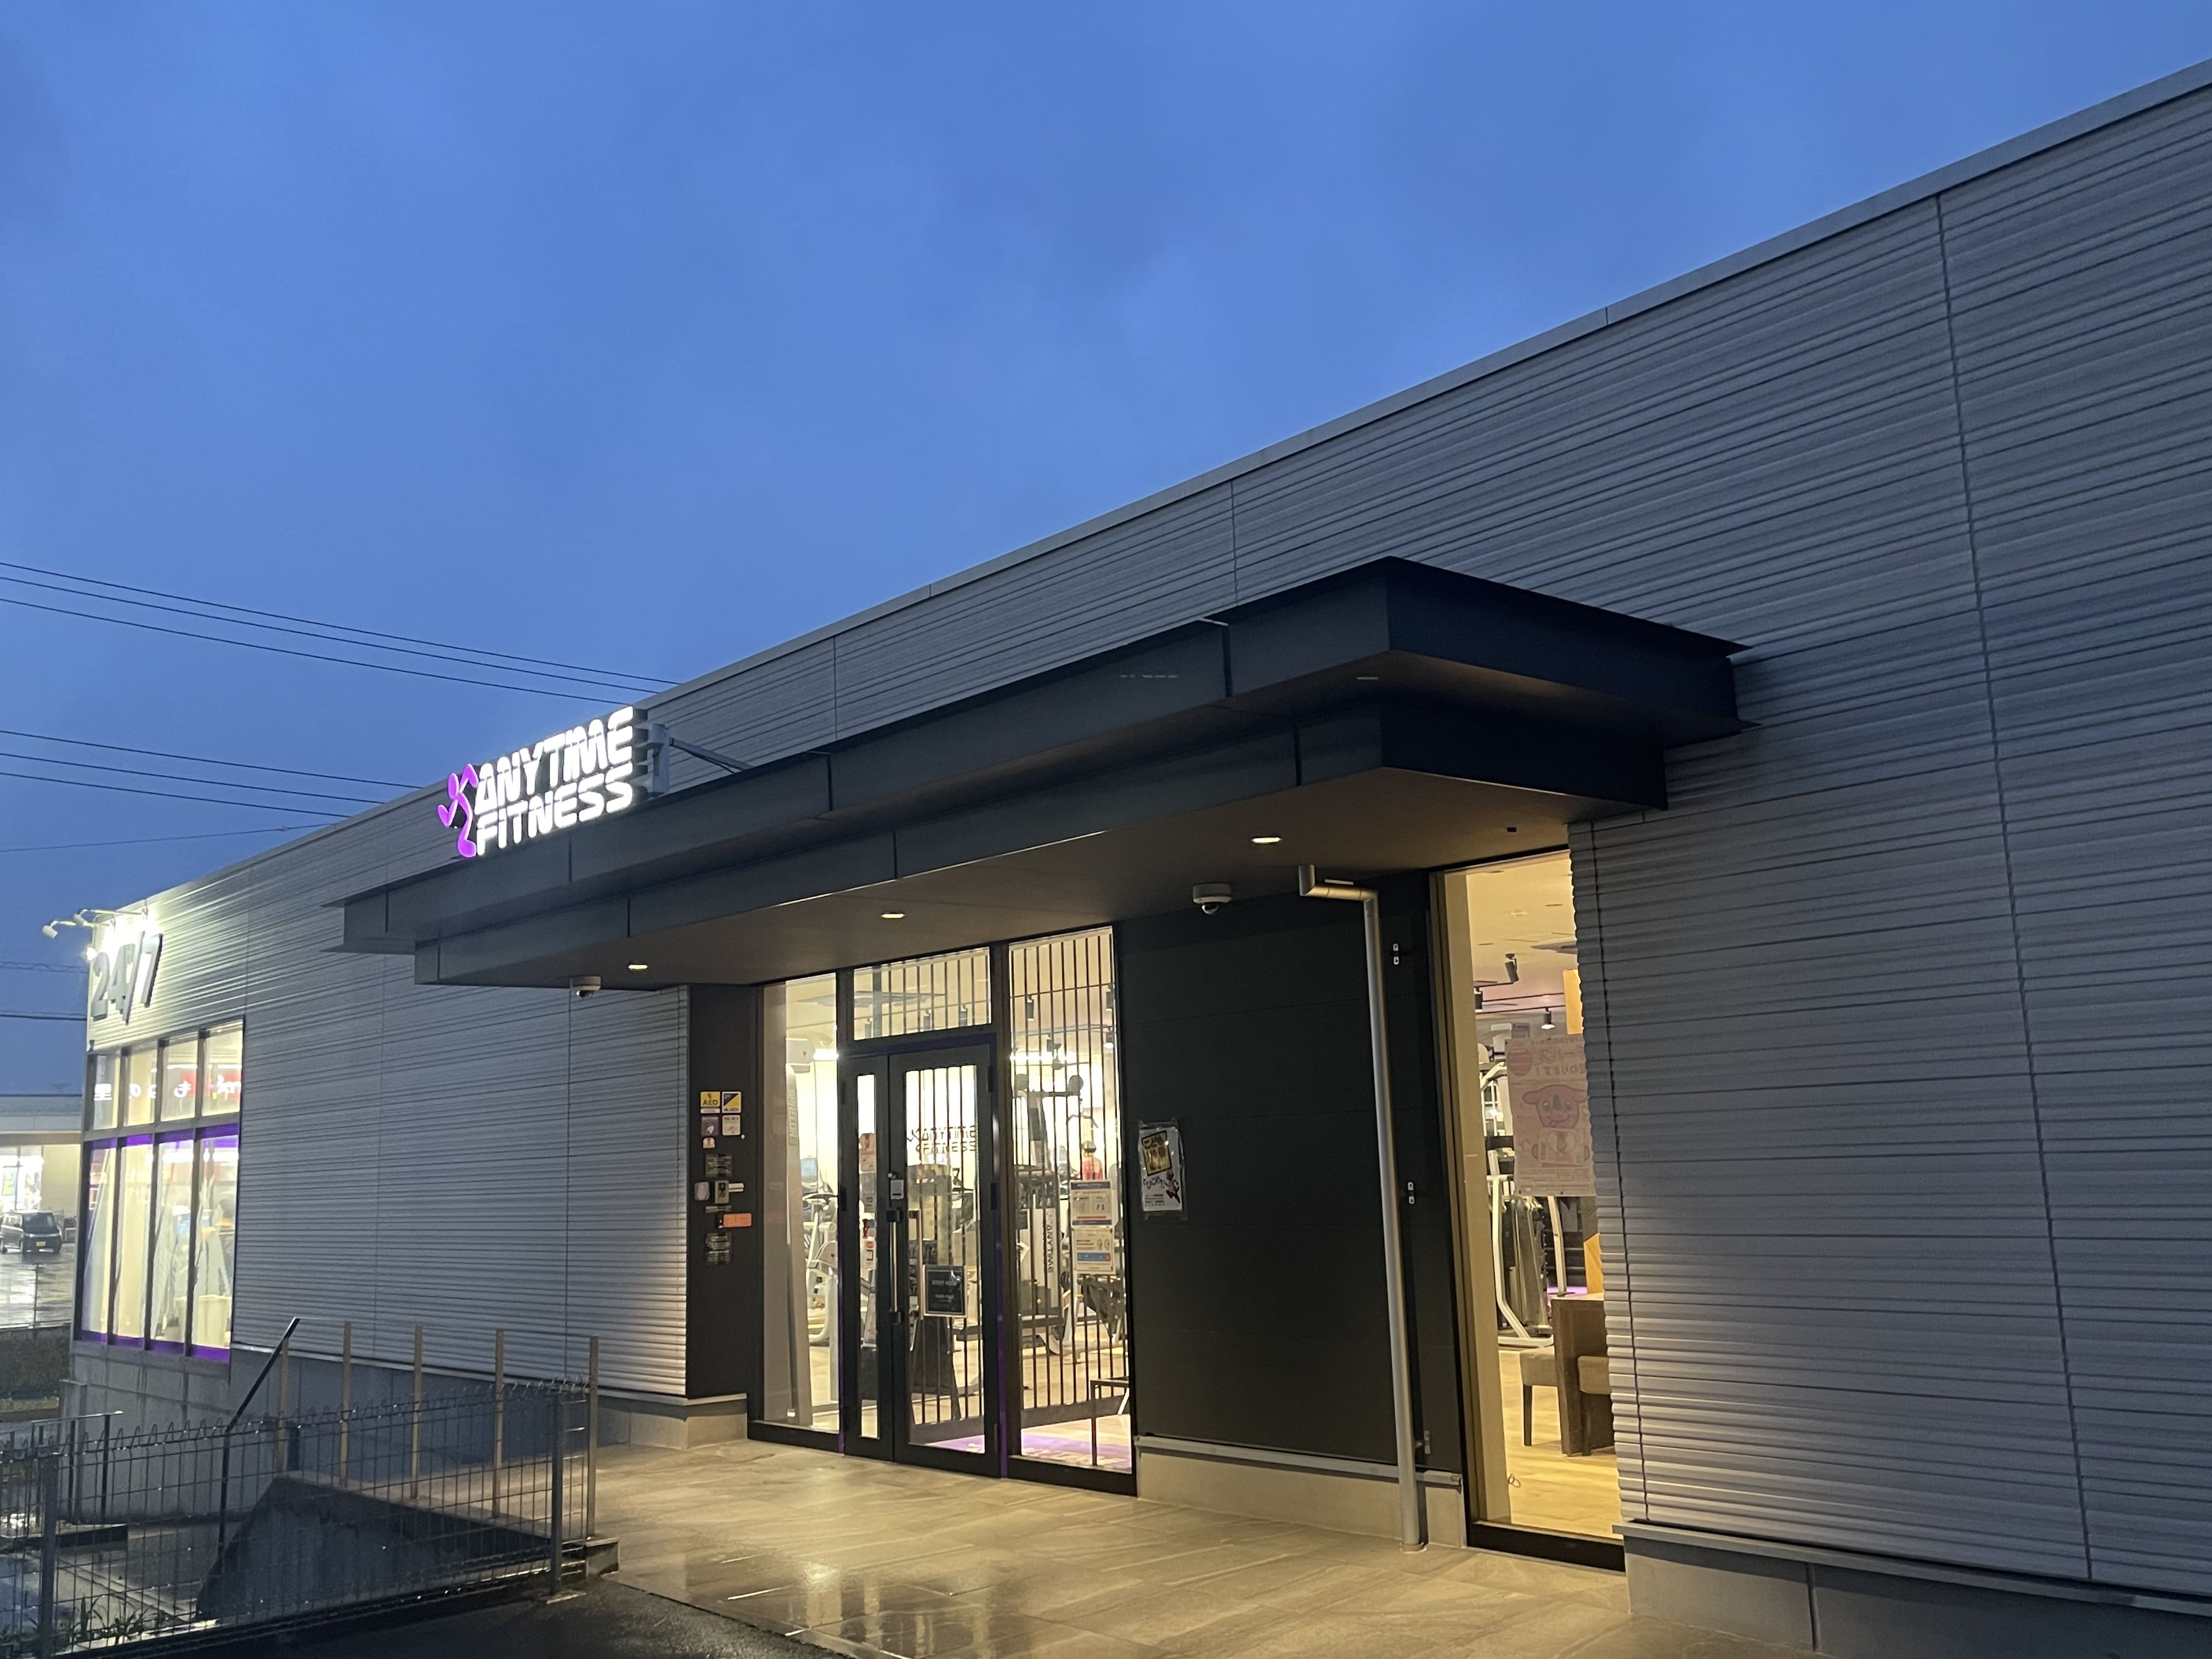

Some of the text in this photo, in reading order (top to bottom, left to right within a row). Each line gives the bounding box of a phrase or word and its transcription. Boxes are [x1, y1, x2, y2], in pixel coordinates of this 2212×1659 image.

[473, 705, 634, 816] ANYTIME
[476, 762, 634, 856] FITNESS
[91, 931, 163, 1024] 24/7
[1046, 1224, 1054, 1273] ANYTIME
